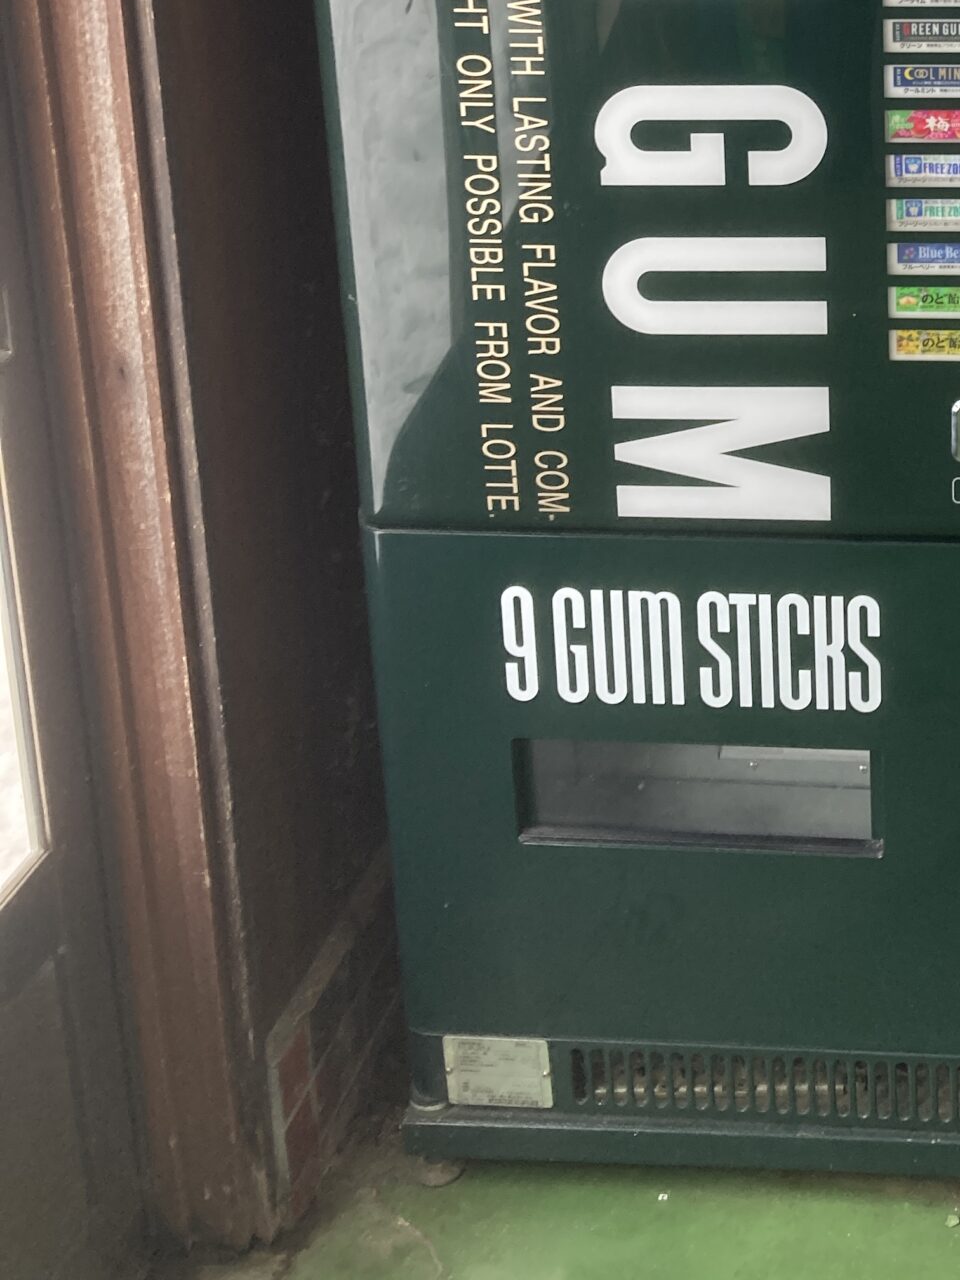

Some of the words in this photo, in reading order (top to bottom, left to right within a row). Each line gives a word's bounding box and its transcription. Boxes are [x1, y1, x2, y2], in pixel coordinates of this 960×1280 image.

[456, 54, 496, 135] ONLY
[512, 96, 555, 225] LASTING
[923, 163, 944, 175] FREE
[463, 153, 507, 302] POSSIBLE
[918, 245, 942, 259] Blue
[924, 206, 945, 217] FREE
[520, 243, 562, 355] FLAVOR
[594, 84, 832, 521] GUM
[921, 292, 960, 305] のど飴
[474, 321, 513, 405] FROM
[922, 337, 960, 350] のど飴
[529, 373, 566, 433] AND
[500, 585, 539, 702] 9
[552, 586, 686, 706] GUM
[697, 590, 882, 714] STICKS
